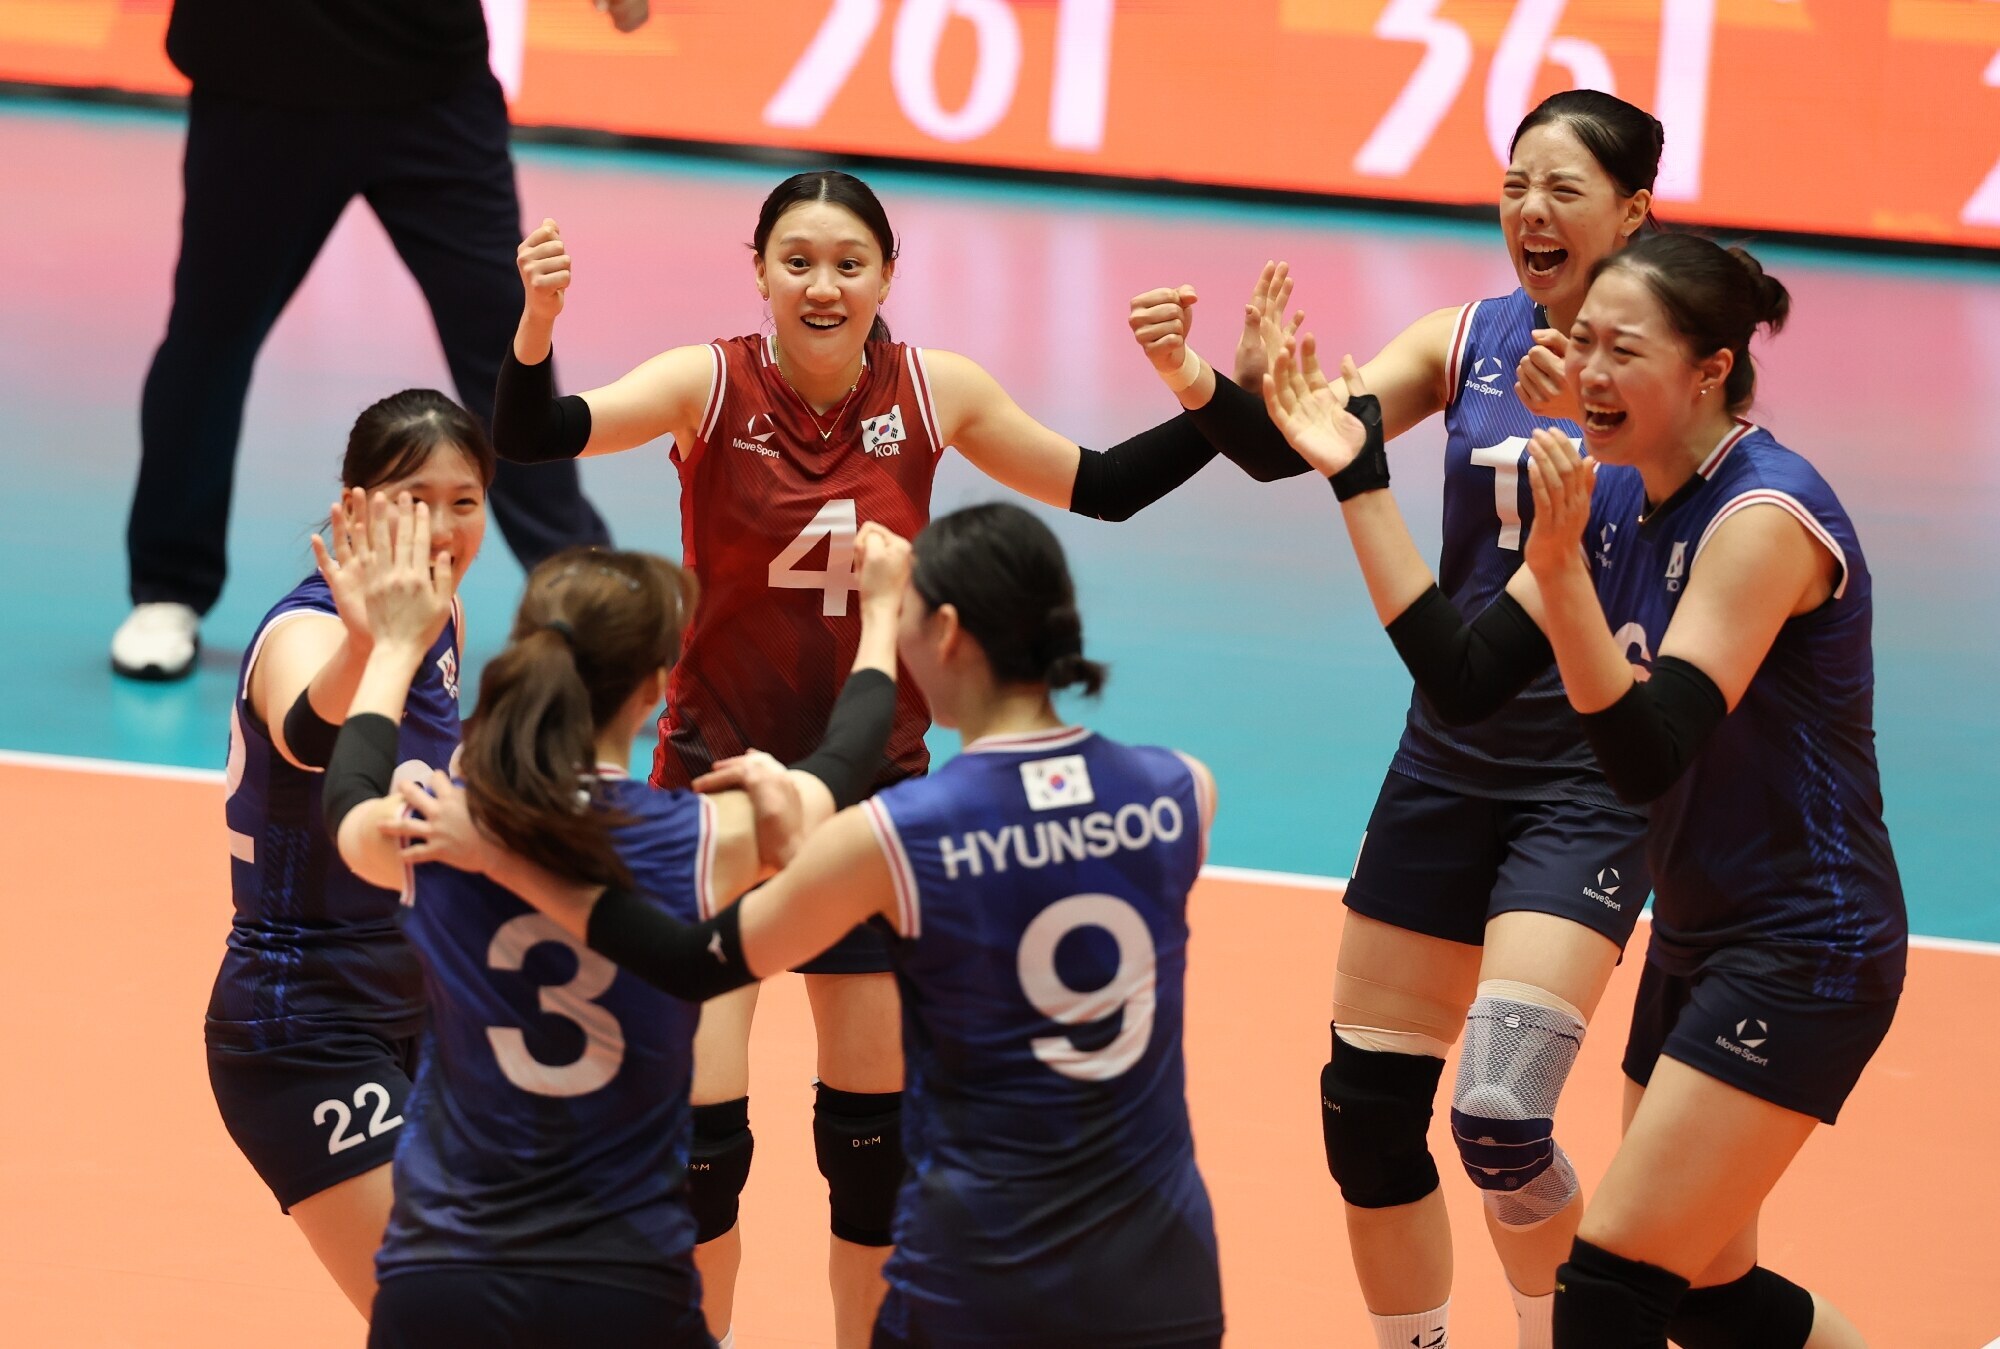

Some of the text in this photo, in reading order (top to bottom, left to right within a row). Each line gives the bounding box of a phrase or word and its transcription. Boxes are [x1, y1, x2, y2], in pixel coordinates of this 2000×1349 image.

[874, 443, 901, 458] KOR
[768, 498, 862, 617] 4
[938, 796, 1183, 880] HYUNSOO
[1582, 886, 1622, 912] MoveSport
[485, 911, 626, 1097] 3
[1016, 893, 1157, 1082] 9
[312, 1081, 406, 1155] 22
